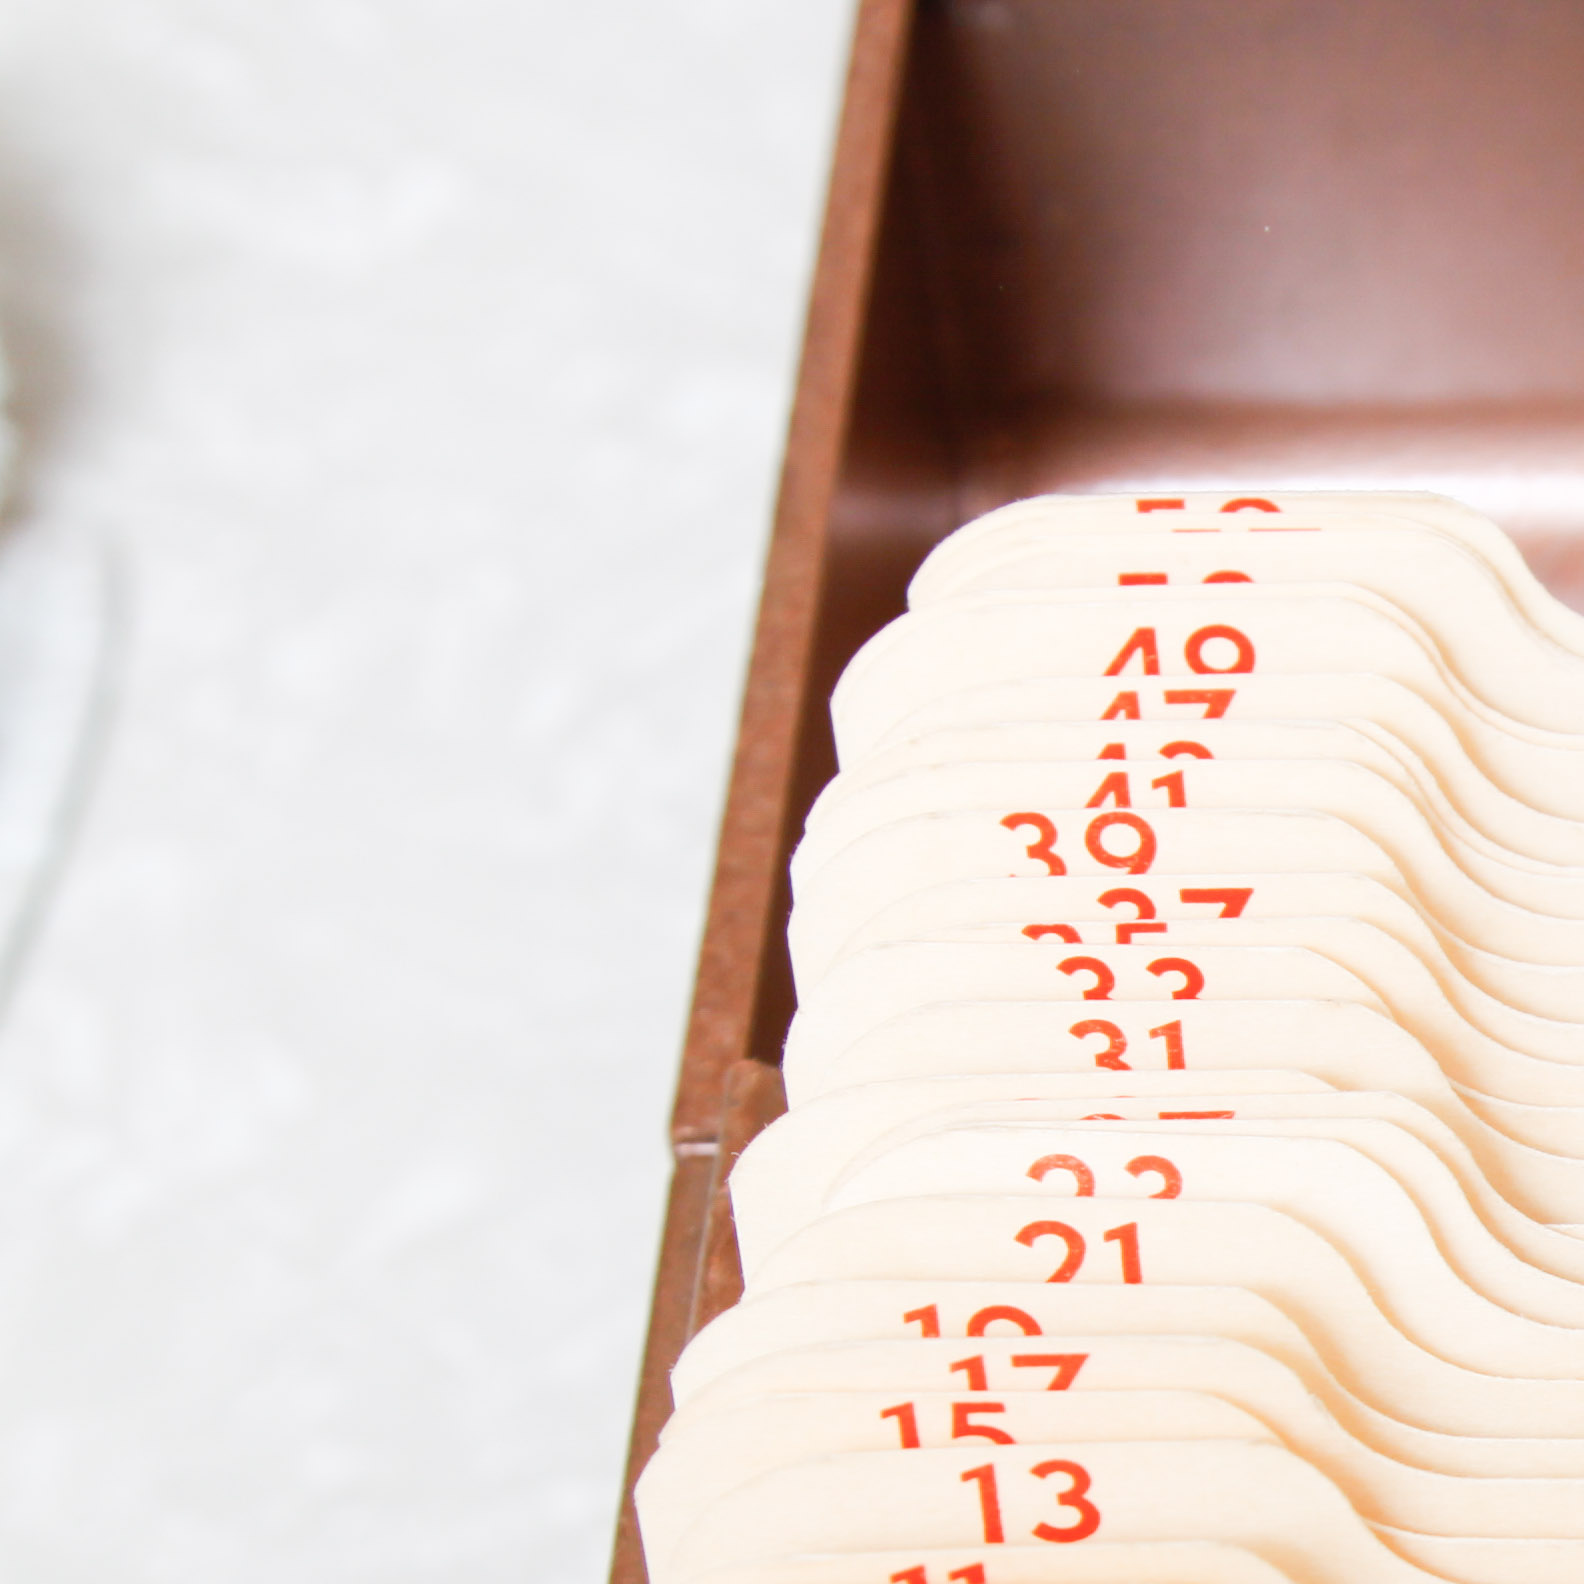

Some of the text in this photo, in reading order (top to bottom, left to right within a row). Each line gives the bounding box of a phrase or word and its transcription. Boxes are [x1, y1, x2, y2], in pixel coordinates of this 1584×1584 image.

[1000, 811, 1158, 877] 39
[1069, 1019, 1188, 1072] 31
[1014, 1220, 1144, 1285] 21
[880, 1401, 1018, 1450] 15
[960, 1459, 1102, 1545] 13
